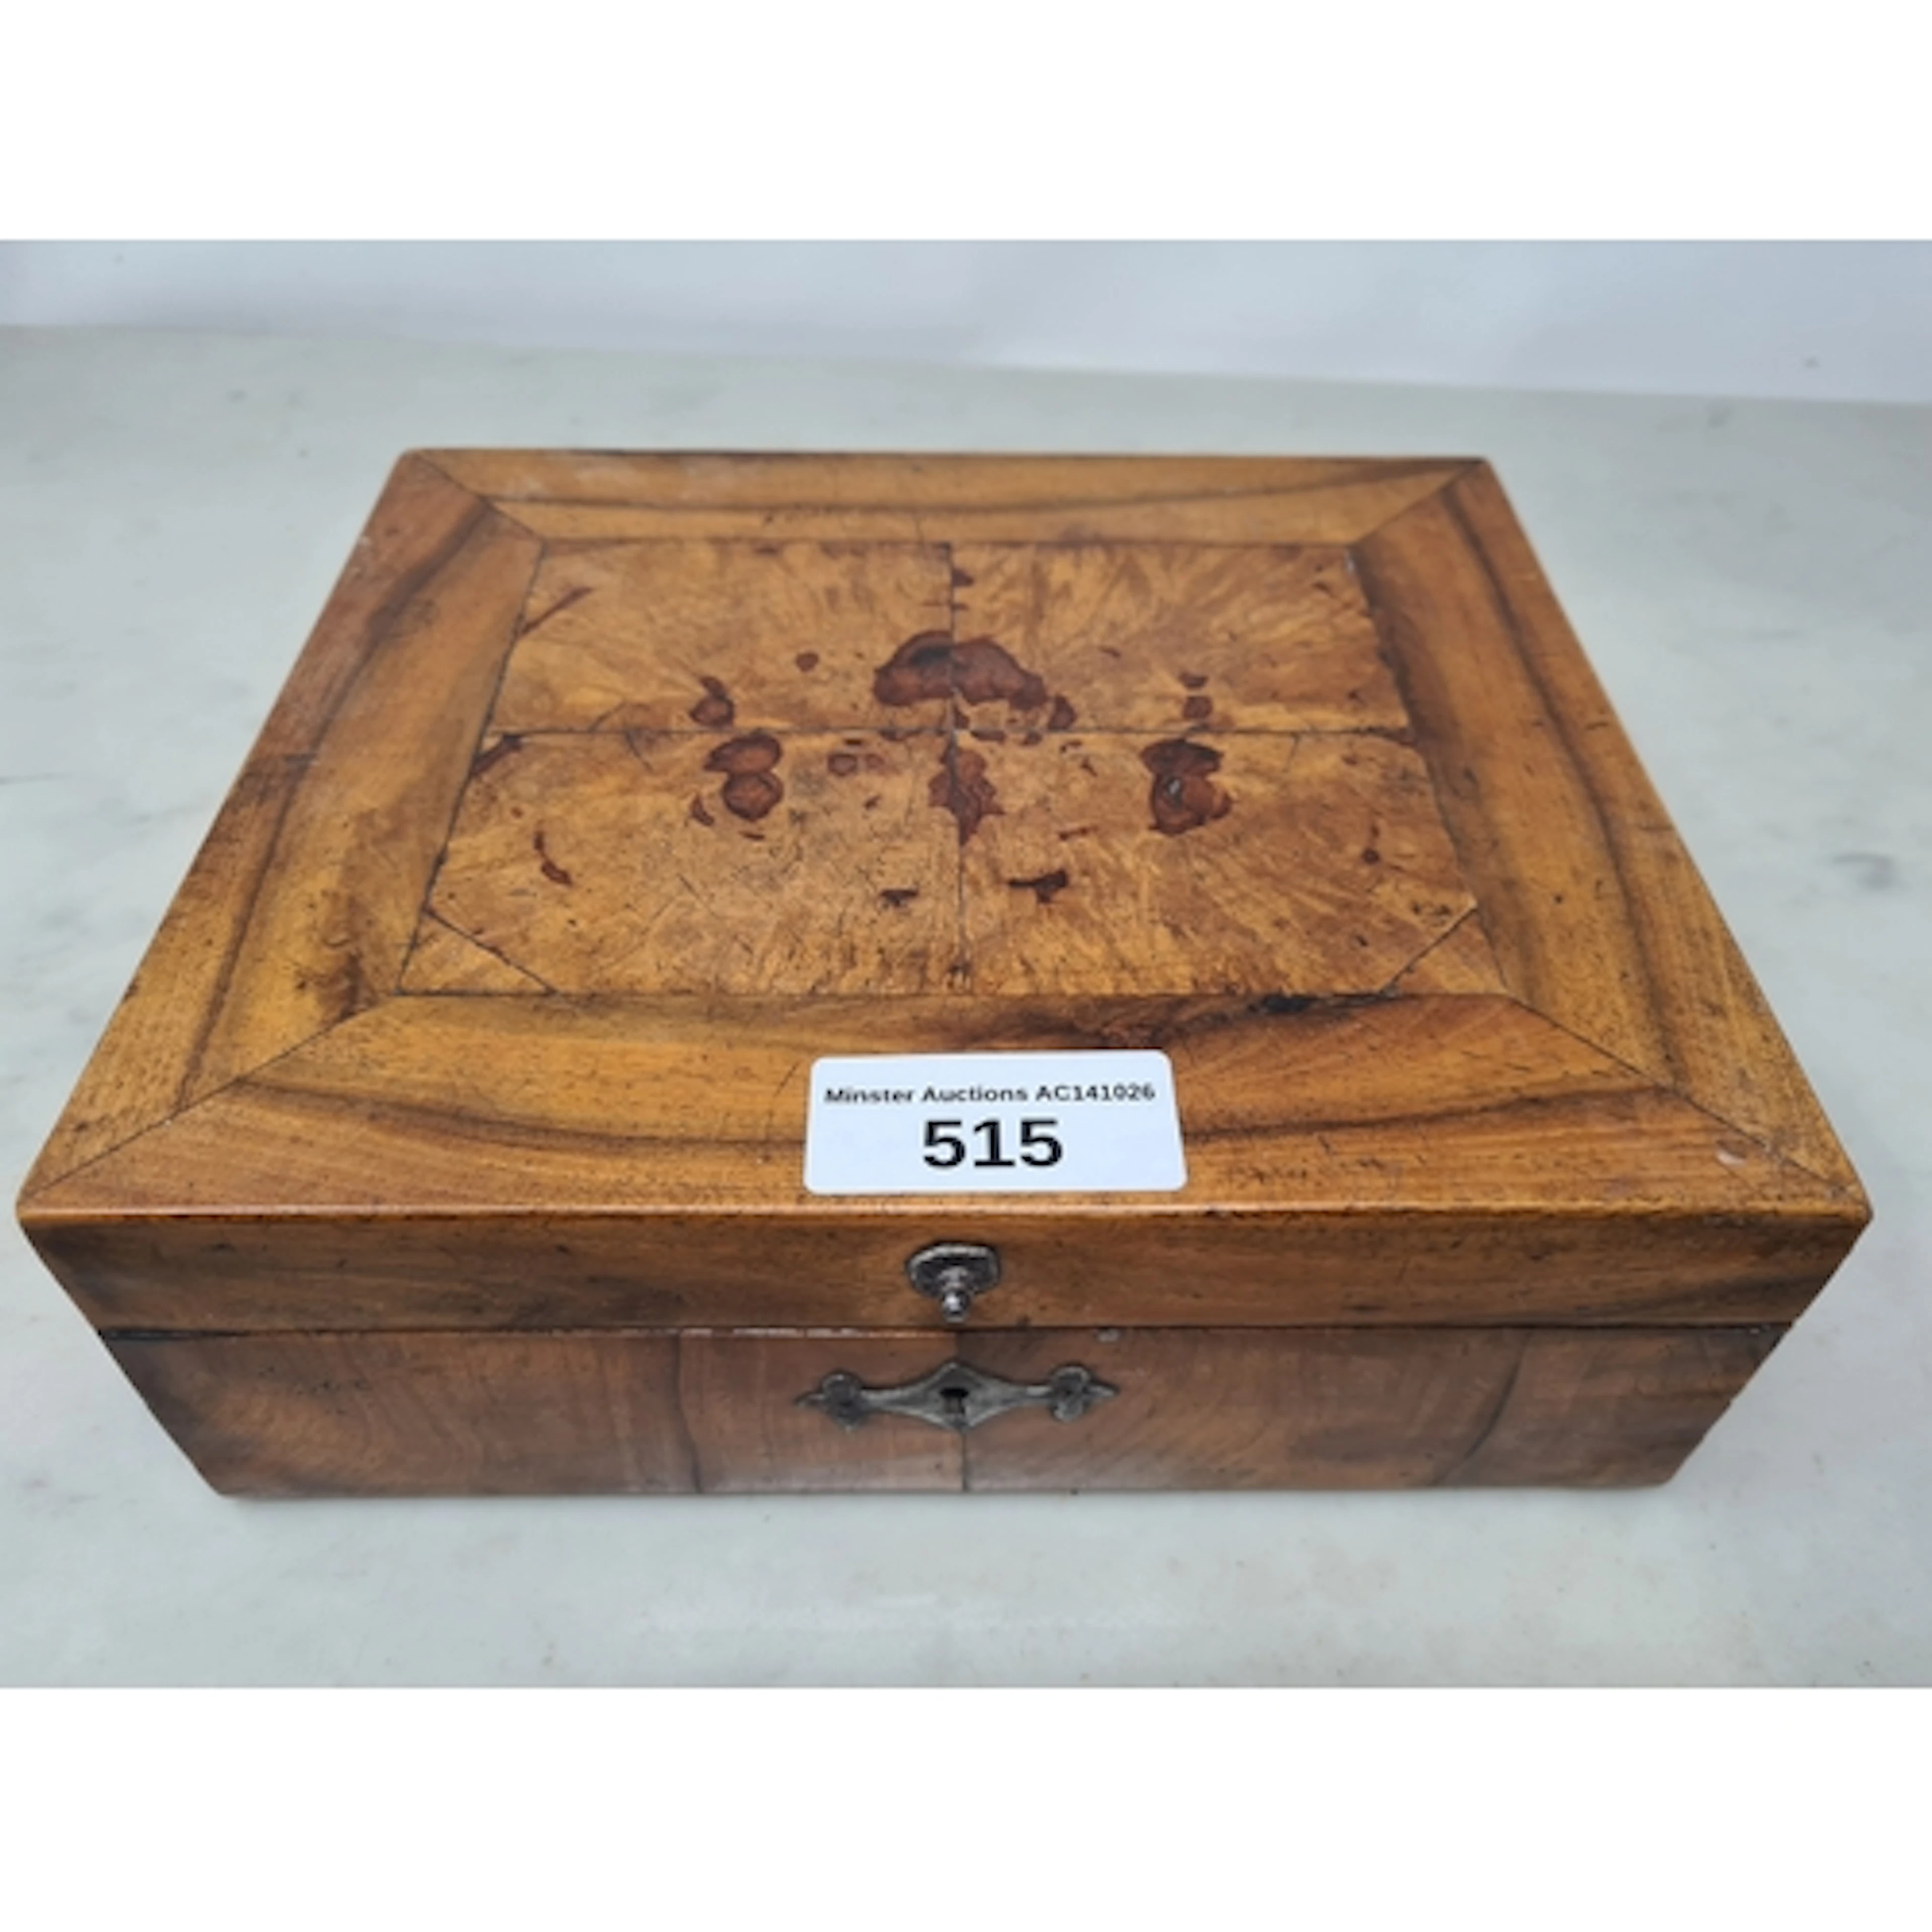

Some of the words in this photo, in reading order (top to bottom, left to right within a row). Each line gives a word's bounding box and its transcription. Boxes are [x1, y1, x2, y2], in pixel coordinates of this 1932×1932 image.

[824, 1087, 915, 1102] Minster
[921, 1085, 1028, 1102] Auctions
[1035, 1083, 1156, 1101] AC141026
[923, 1119, 1063, 1168] 515
